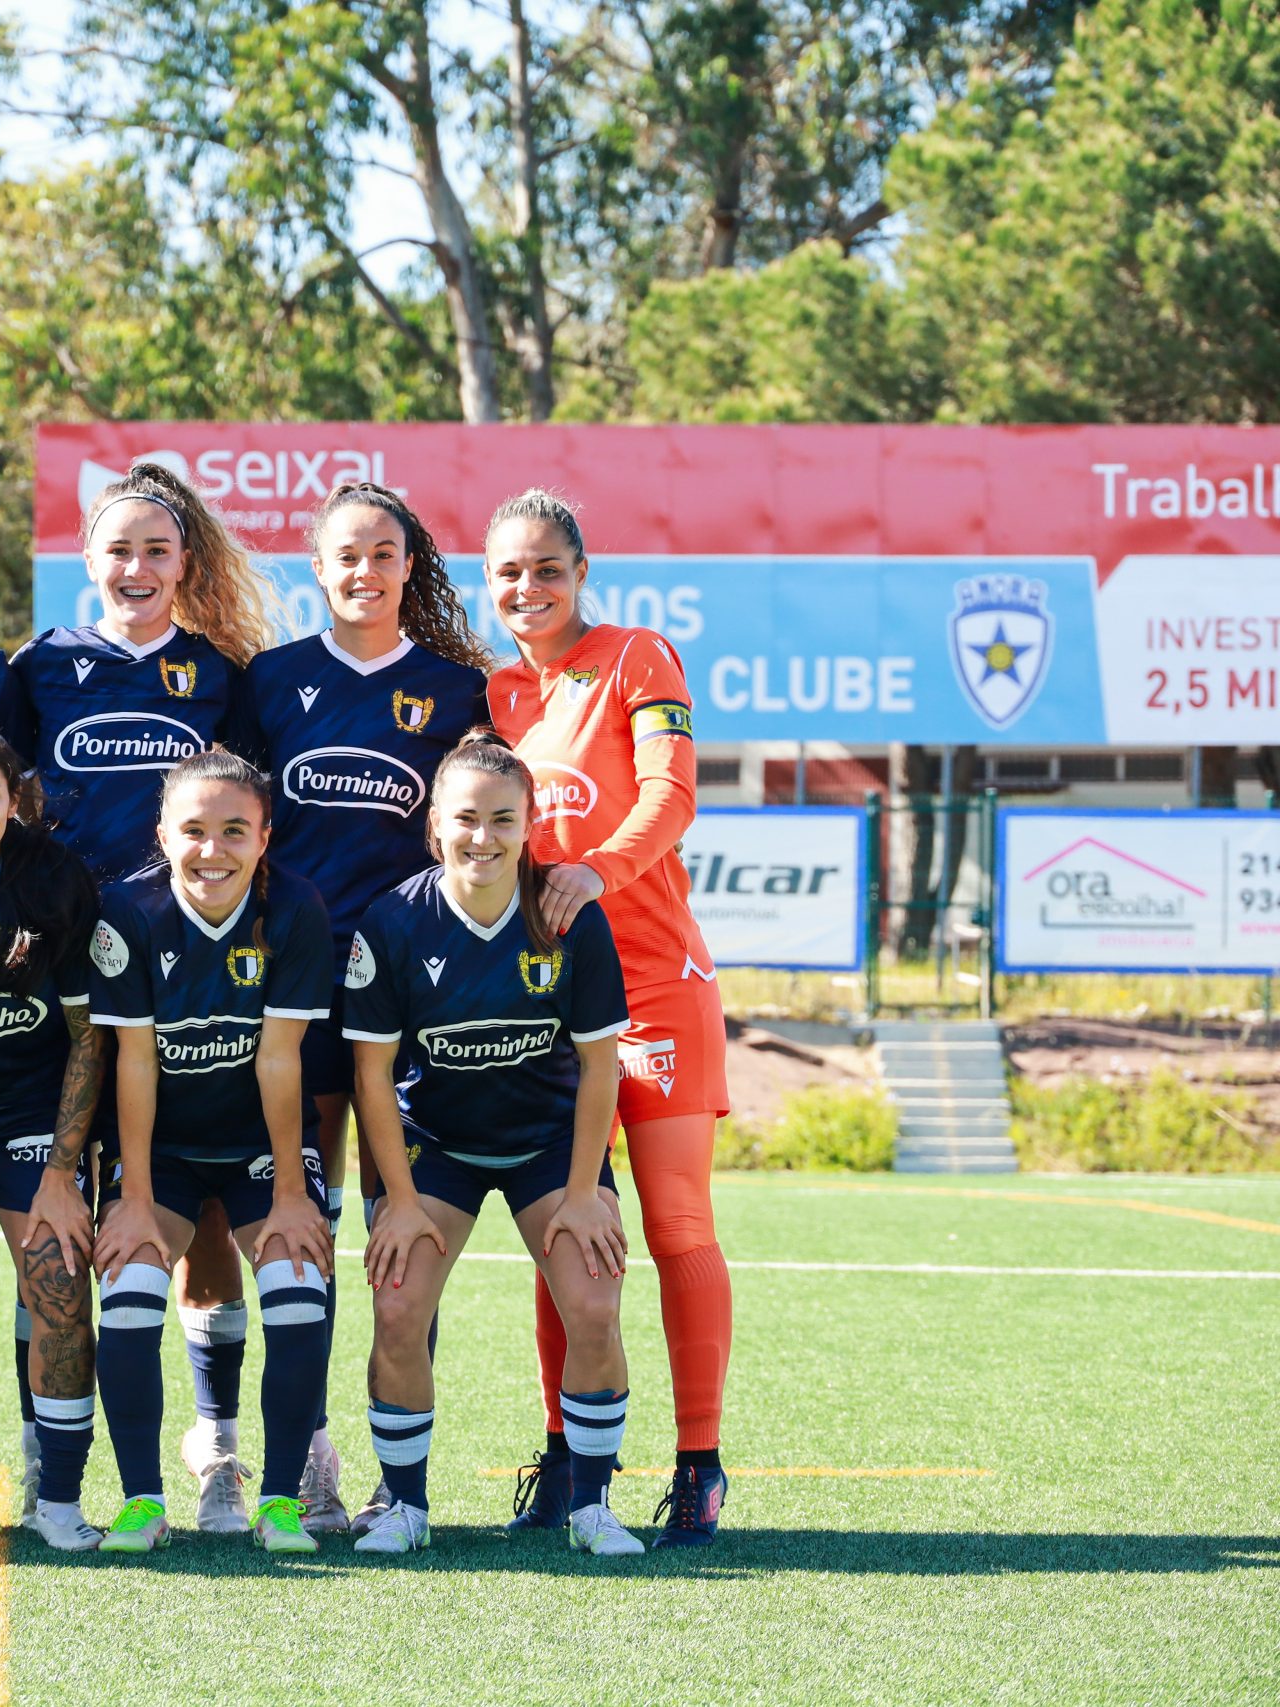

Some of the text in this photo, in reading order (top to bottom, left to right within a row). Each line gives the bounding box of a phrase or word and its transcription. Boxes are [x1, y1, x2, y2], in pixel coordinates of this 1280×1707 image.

[1091, 463, 1280, 519] Trabal
[709, 656, 915, 713] CLUBE
[1146, 668, 1276, 714] 2,5 MI
[71, 731, 195, 759] Porminho
[298, 765, 413, 802] Porminho
[535, 781, 580, 807] inho
[1047, 870, 1111, 898] ora
[354, 969, 368, 983] BPI
[433, 1029, 548, 1058] Porminho
